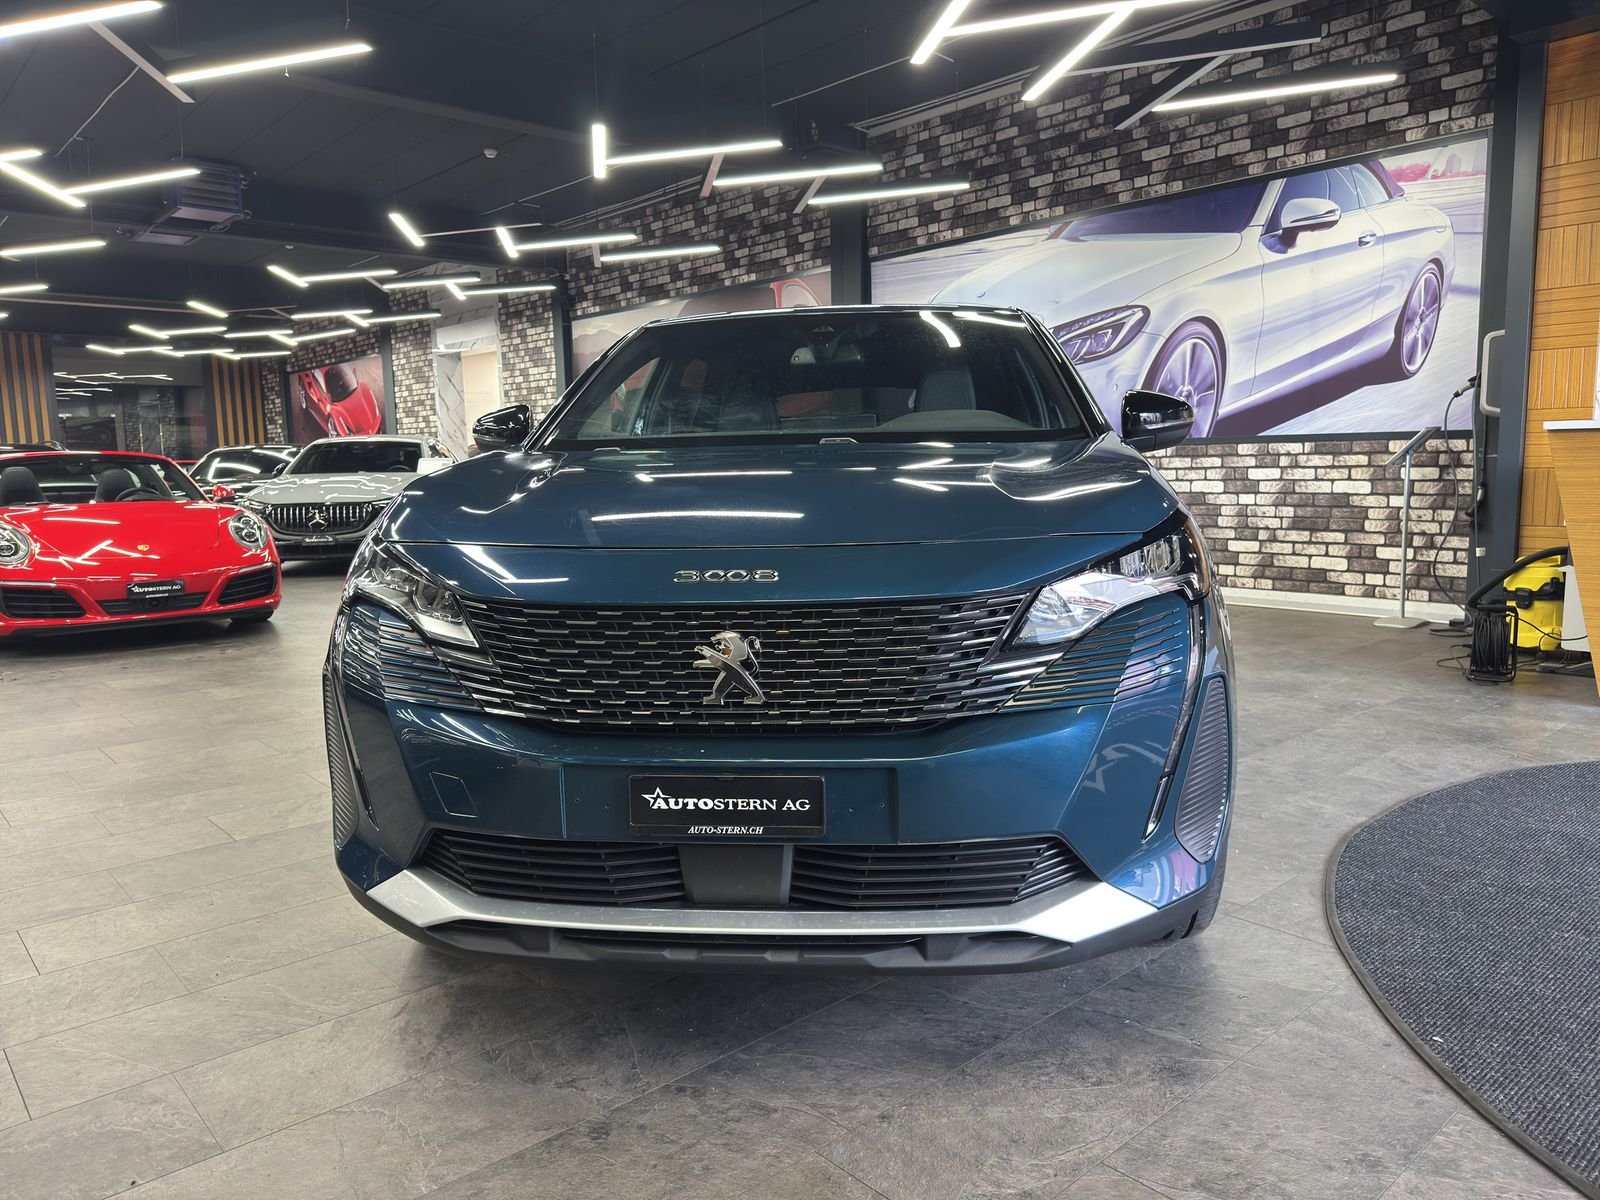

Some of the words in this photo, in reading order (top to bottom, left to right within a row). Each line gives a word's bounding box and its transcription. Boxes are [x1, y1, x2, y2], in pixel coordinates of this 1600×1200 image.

[671, 569, 780, 583] 3008
[650, 796, 777, 811] AUTOSTERN
[781, 799, 812, 811] AG
[687, 826, 765, 835] AUTO-STERN.CH
